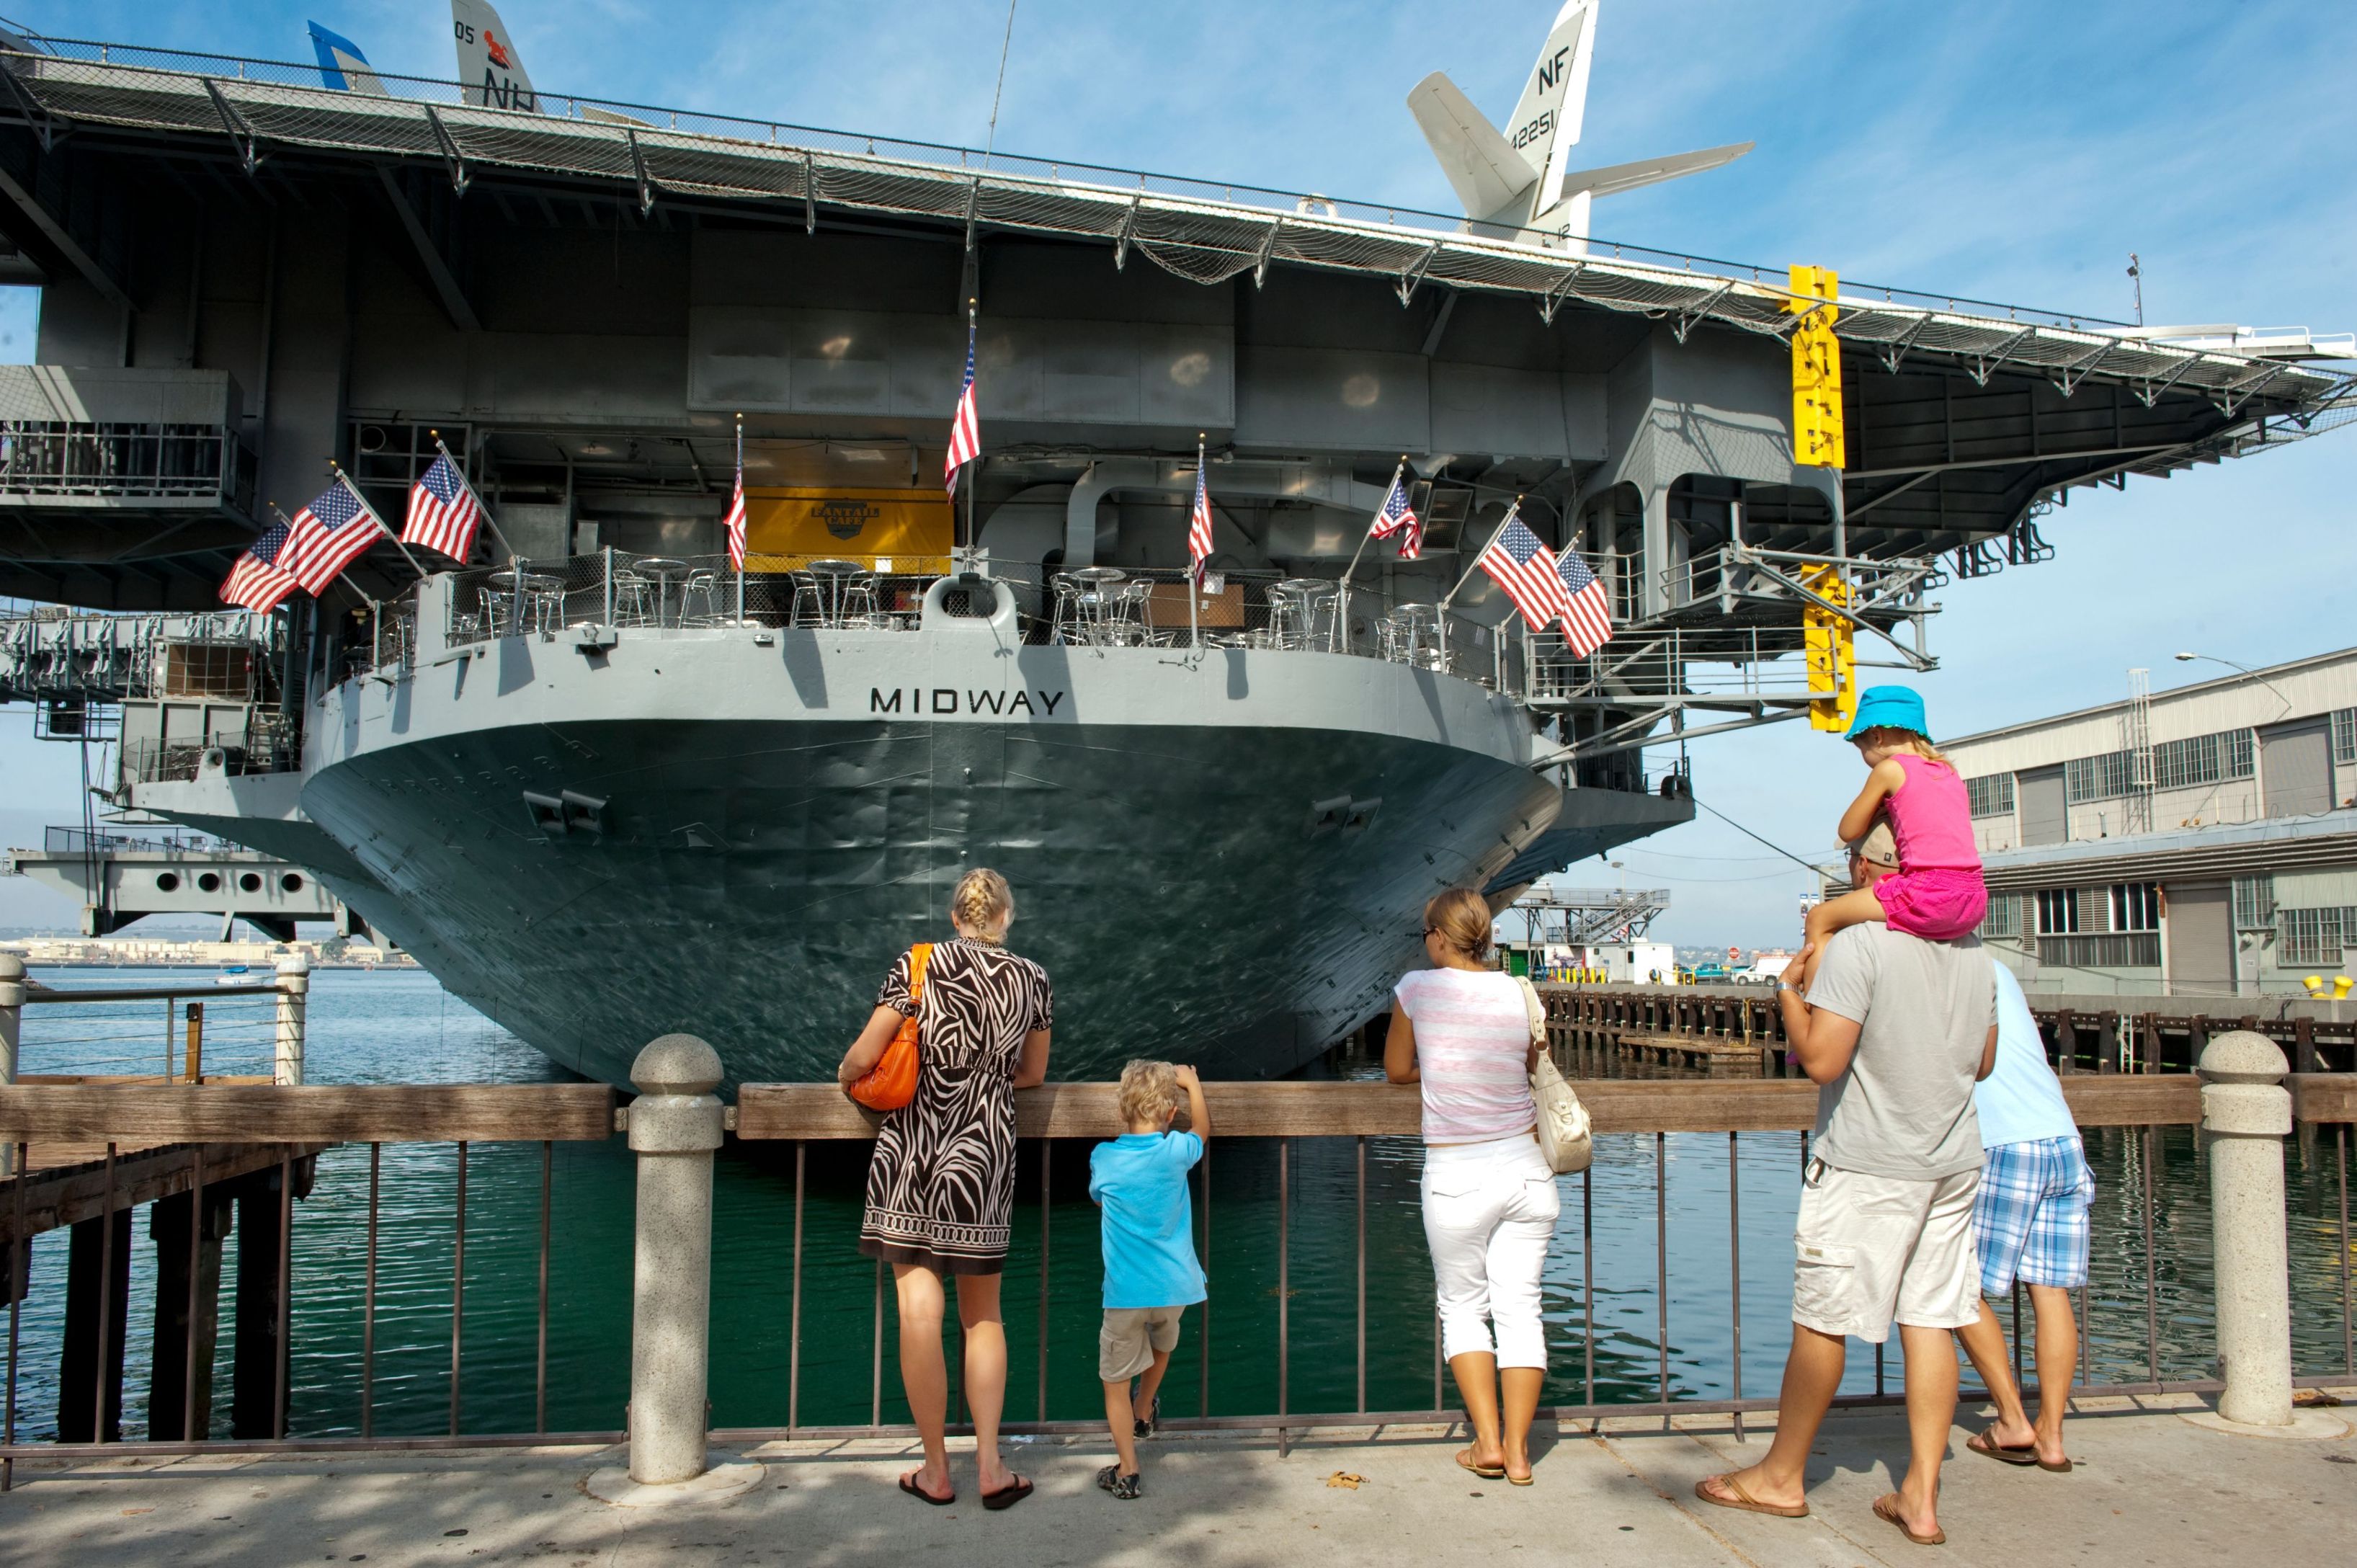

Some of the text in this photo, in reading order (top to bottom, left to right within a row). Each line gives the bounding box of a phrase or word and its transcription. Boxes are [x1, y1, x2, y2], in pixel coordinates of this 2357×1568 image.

[455, 20, 475, 45] 05
[1539, 45, 1569, 96] NF
[813, 507, 879, 517] FANTAIL
[827, 516, 863, 525] CAFE
[870, 687, 1064, 716] MIDWAY
